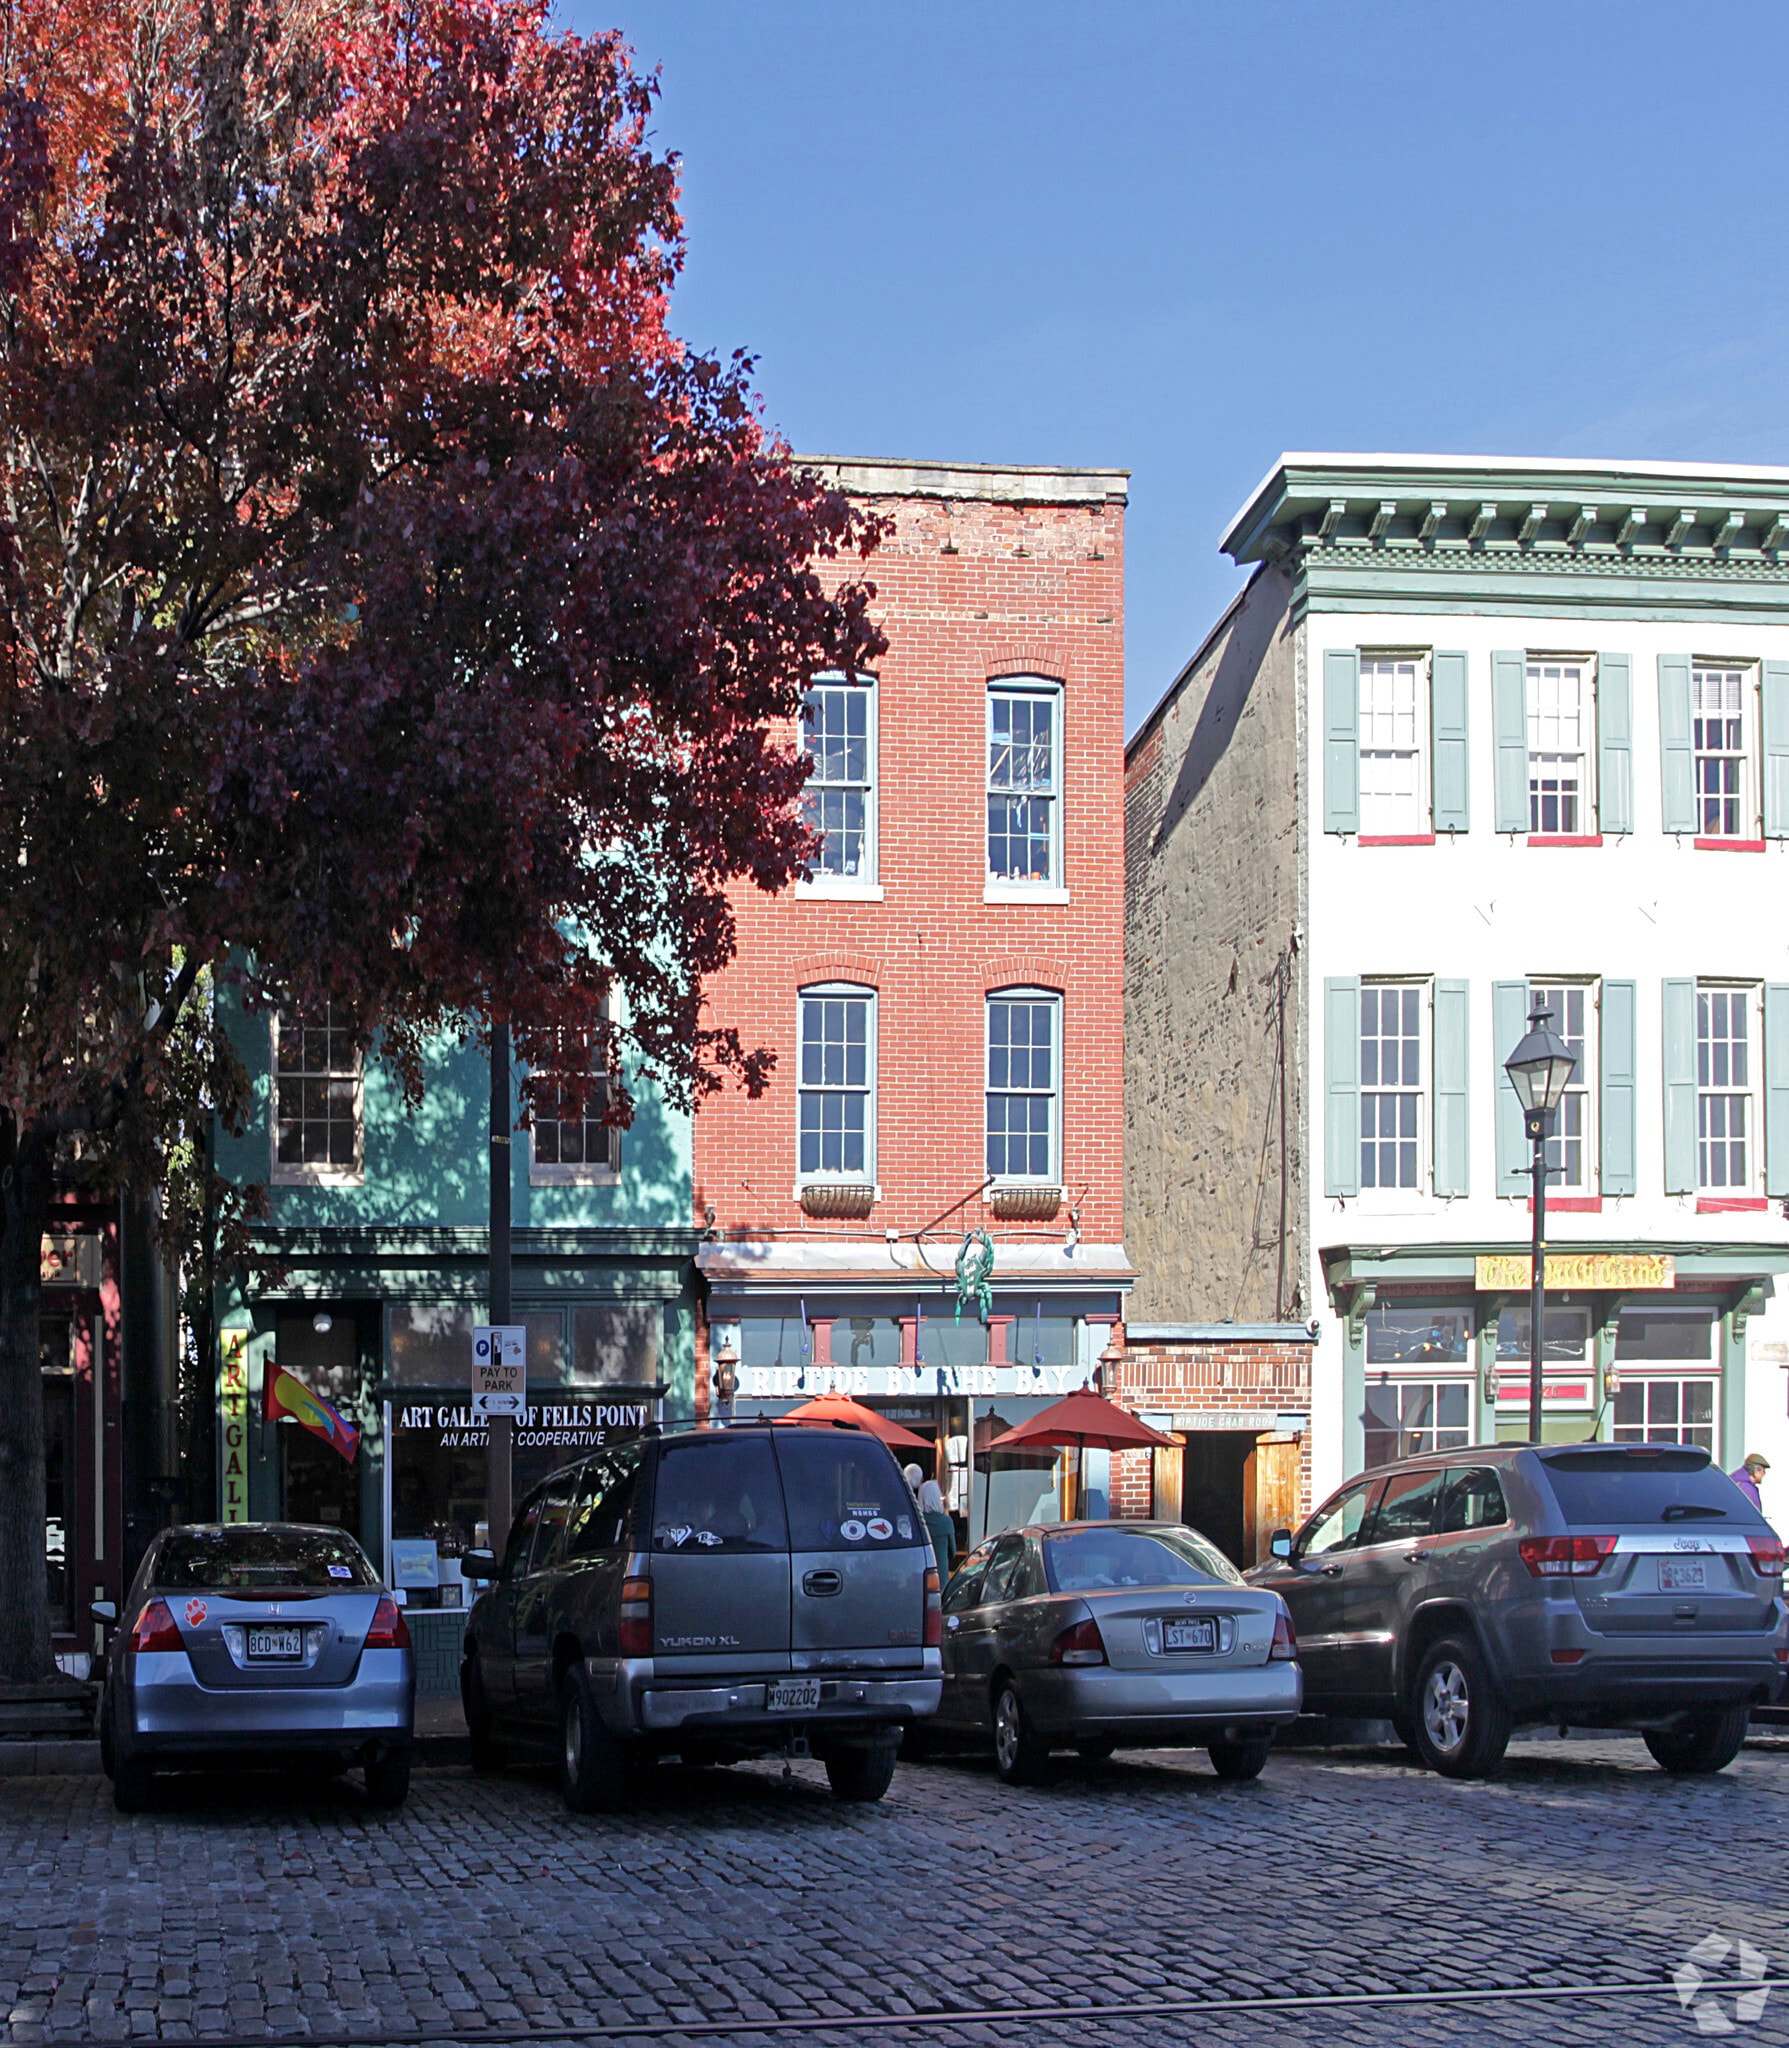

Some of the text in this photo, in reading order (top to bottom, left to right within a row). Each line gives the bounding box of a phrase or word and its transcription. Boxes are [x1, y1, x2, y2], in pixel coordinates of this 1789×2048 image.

[1483, 1258, 1526, 1287] The
[1600, 1256, 1665, 1287] Grind
[226, 1334, 242, 1416] ART
[480, 1367, 517, 1377] PAY TO
[485, 1380, 512, 1391] PARK
[752, 1367, 868, 1396] RIPTIDE
[886, 1367, 922, 1395] BY
[1015, 1366, 1072, 1395] BAY
[400, 1405, 648, 1428] ART GALLE OF FELLS POINT
[1175, 1416, 1214, 1428] RIPTIDE
[1248, 1417, 1276, 1428] ROOM
[441, 1432, 459, 1446] AN
[518, 1431, 606, 1446] COOPERATIVE
[1674, 1538, 1700, 1552] Jeep
[250, 1636, 300, 1653] 8CD W62
[660, 1636, 740, 1647] YUKON XL
[1166, 1629, 1211, 1646] LST 670
